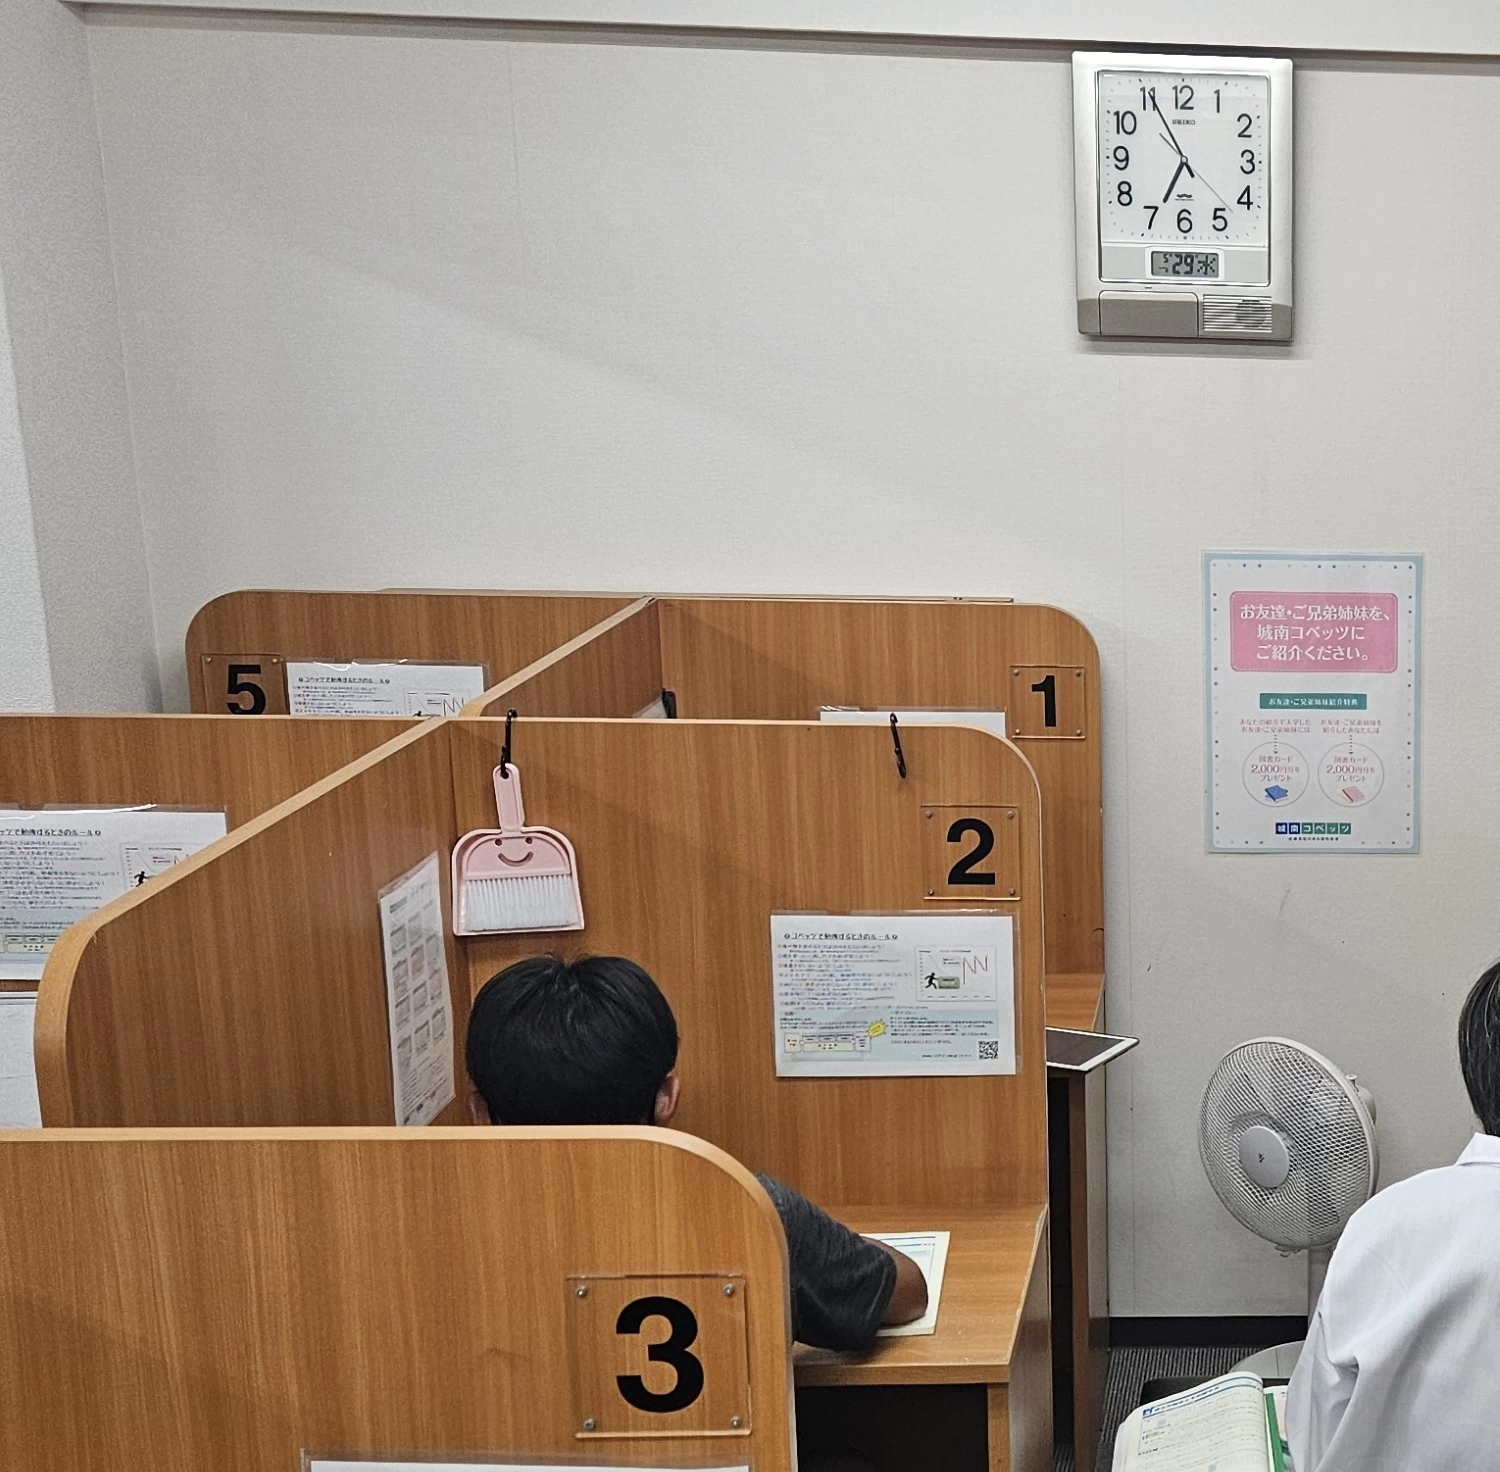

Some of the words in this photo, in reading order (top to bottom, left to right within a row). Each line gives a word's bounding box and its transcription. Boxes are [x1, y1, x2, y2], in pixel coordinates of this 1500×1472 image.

[1139, 86, 1157, 111] 11
[1172, 85, 1194, 110] 12
[1213, 89, 1221, 113] 1
[1113, 111, 1137, 135] 10
[1236, 114, 1252, 138] 2
[1113, 146, 1129, 170] 9
[1240, 149, 1256, 174] 3
[1117, 181, 1133, 207] 8
[1236, 185, 1253, 210] 4
[1143, 206, 1159, 230] 7
[1176, 209, 1193, 233] 6
[1212, 208, 1228, 231] 5
[1172, 254, 1194, 275] 29
[1240, 604, 1390, 622] お友達・ご兄弟姉妹を、
[1257, 624, 1365, 641] 城南コベッツに
[1256, 645, 1369, 661] ご紹介ください。
[225, 664, 266, 714] 5
[1032, 675, 1056, 727] 1
[947, 819, 995, 885] 2
[616, 1297, 704, 1413] 3
